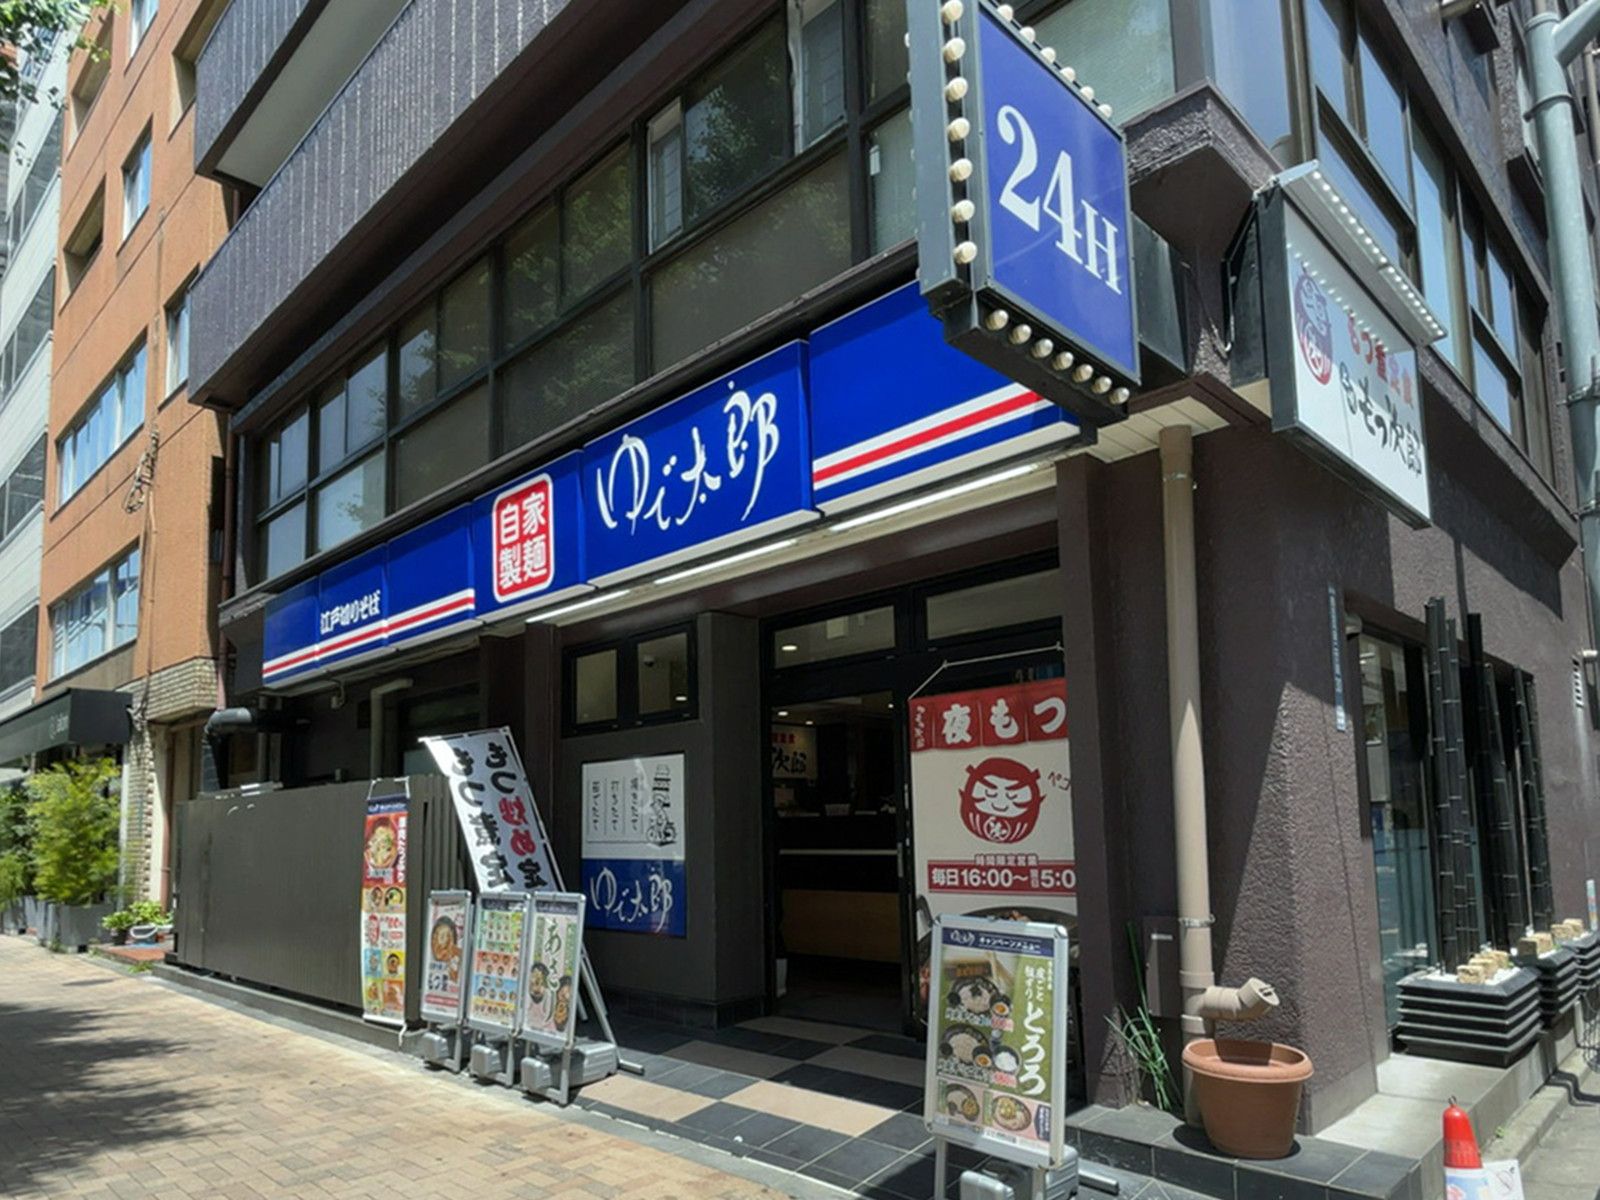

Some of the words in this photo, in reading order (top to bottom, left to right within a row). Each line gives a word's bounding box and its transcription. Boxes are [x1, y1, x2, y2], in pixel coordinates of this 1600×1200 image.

[997, 105, 1122, 295] 24H
[597, 380, 779, 535] ゆで太郎
[320, 589, 381, 635] 江戸切りそば
[590, 867, 673, 933] ゆで太郎
[1019, 1001, 1047, 1096] とろろ
